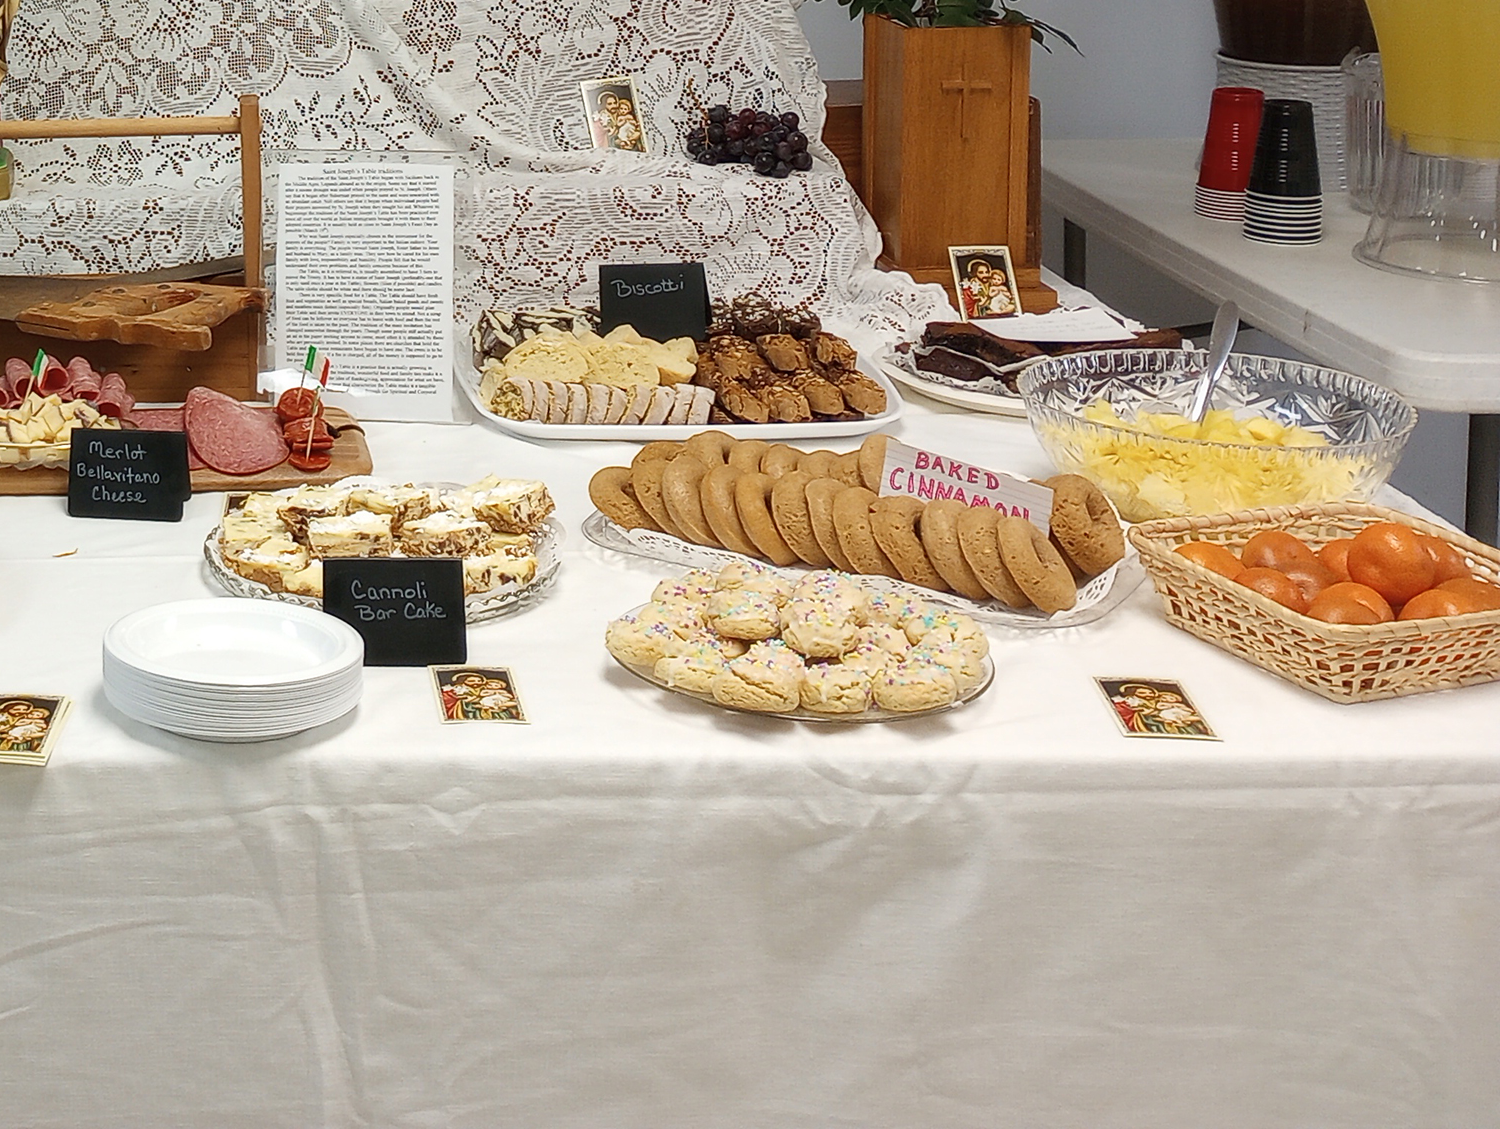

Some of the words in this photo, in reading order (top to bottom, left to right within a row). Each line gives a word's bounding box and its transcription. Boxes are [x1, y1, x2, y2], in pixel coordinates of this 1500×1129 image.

[610, 274, 684, 298] Biscotti
[89, 440, 147, 460] Merlot
[915, 451, 1000, 490] BAKED
[92, 485, 147, 503] Cheese
[351, 579, 427, 600] Cannoli
[354, 605, 396, 621] Bar
[404, 601, 447, 619] Cake
